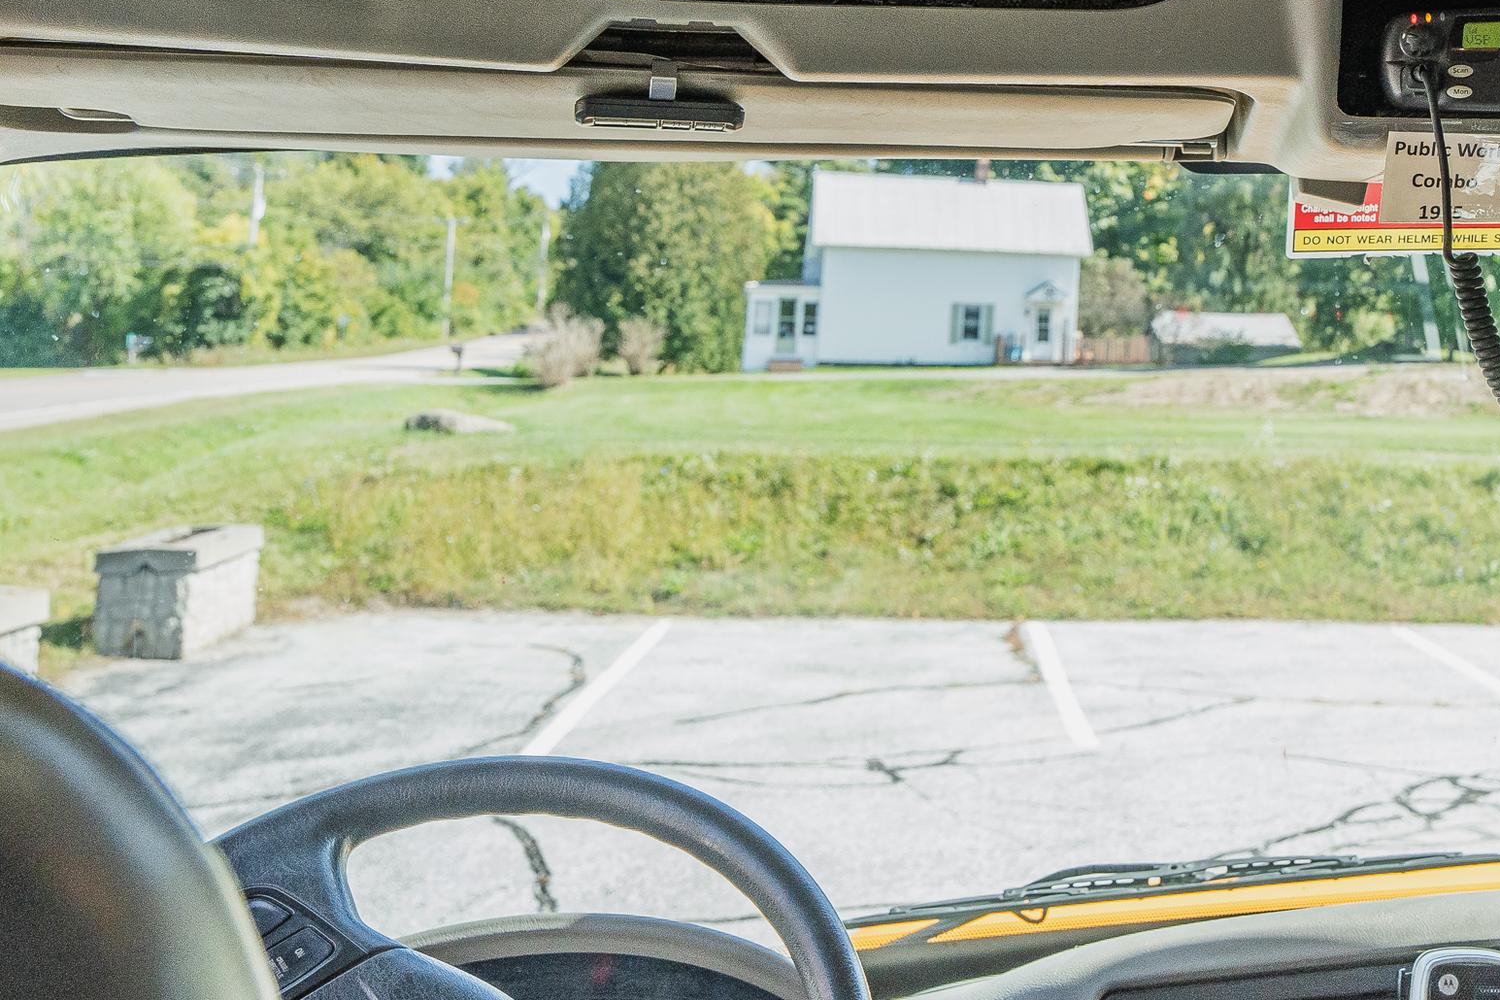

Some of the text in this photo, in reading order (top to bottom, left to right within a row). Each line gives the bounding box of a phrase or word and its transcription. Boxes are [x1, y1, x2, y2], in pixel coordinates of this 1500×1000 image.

[1395, 141, 1452, 157] Publc
[1313, 213, 1377, 223] shall be noted
[1419, 205, 1463, 219] 195
[1303, 236, 1321, 245] DO
[1326, 235, 1352, 245] NOT
[1356, 235, 1393, 244] WEAR
[1397, 234, 1444, 244] HELMET
[1452, 233, 1488, 243] WHILE
